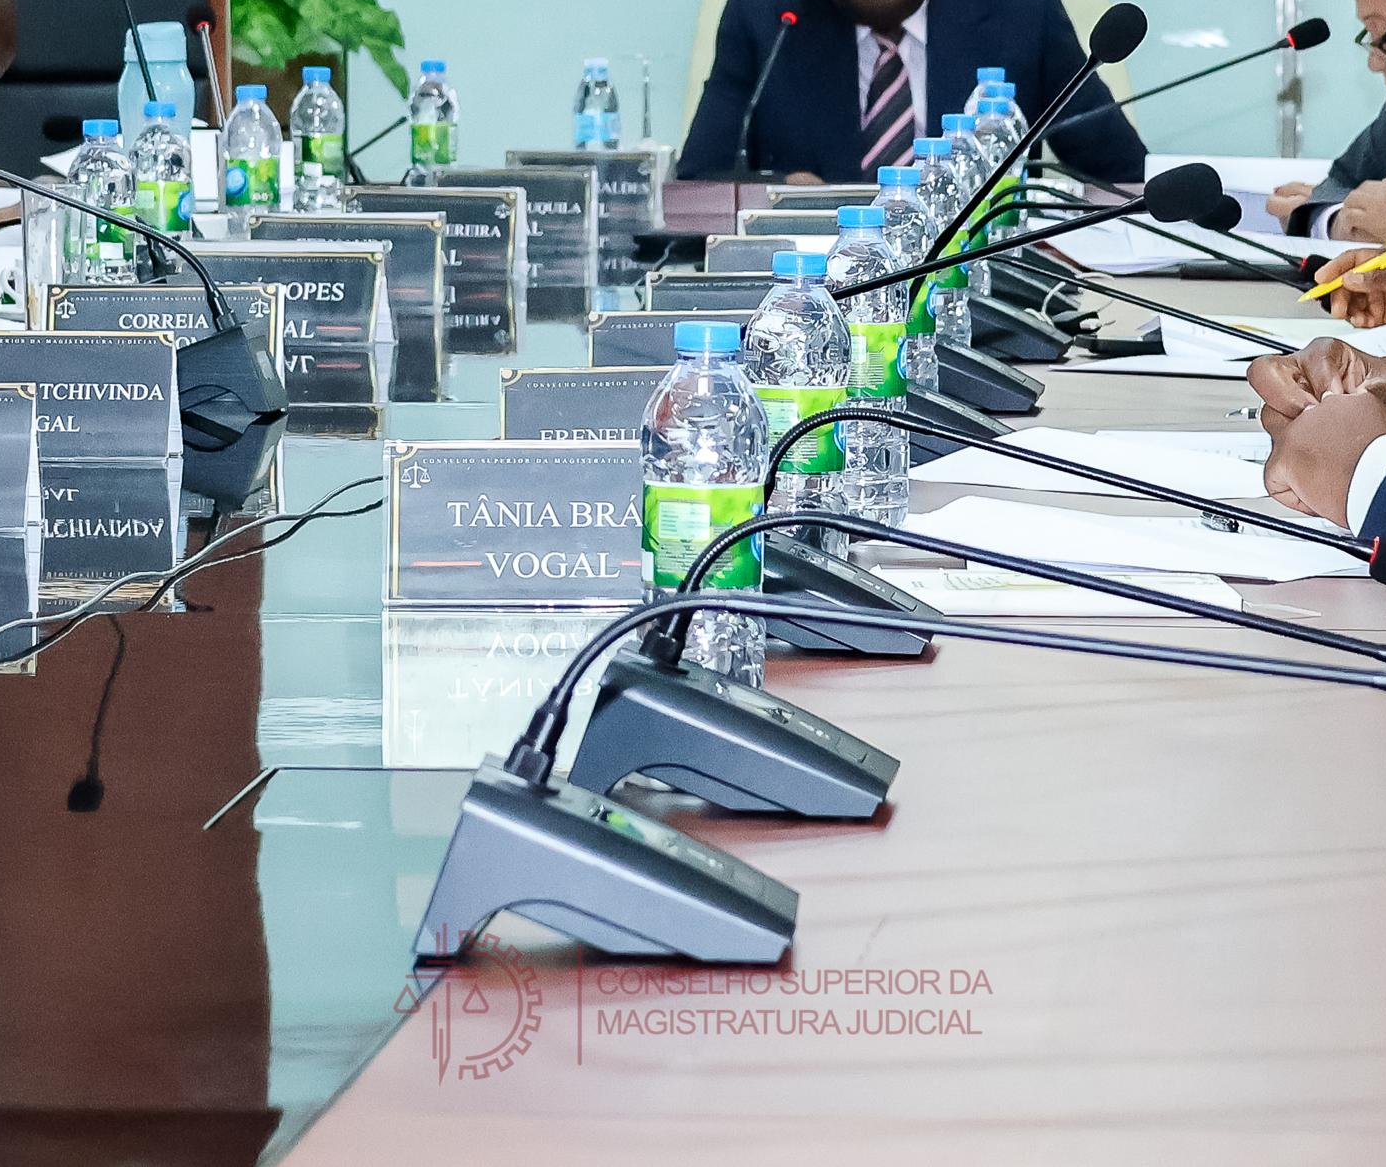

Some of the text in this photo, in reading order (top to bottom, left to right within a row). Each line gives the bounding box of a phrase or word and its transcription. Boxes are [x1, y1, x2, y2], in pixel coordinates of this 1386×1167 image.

[446, 223, 502, 238] EREIRA
[284, 282, 345, 302] OPES
[118, 313, 210, 330] CORREIA
[39, 382, 165, 401] TCHIVINDA
[36, 414, 81, 433] GAL
[446, 494, 562, 529] TÂNIA
[568, 494, 644, 529] BRÁ
[484, 551, 621, 579] VOGAL
